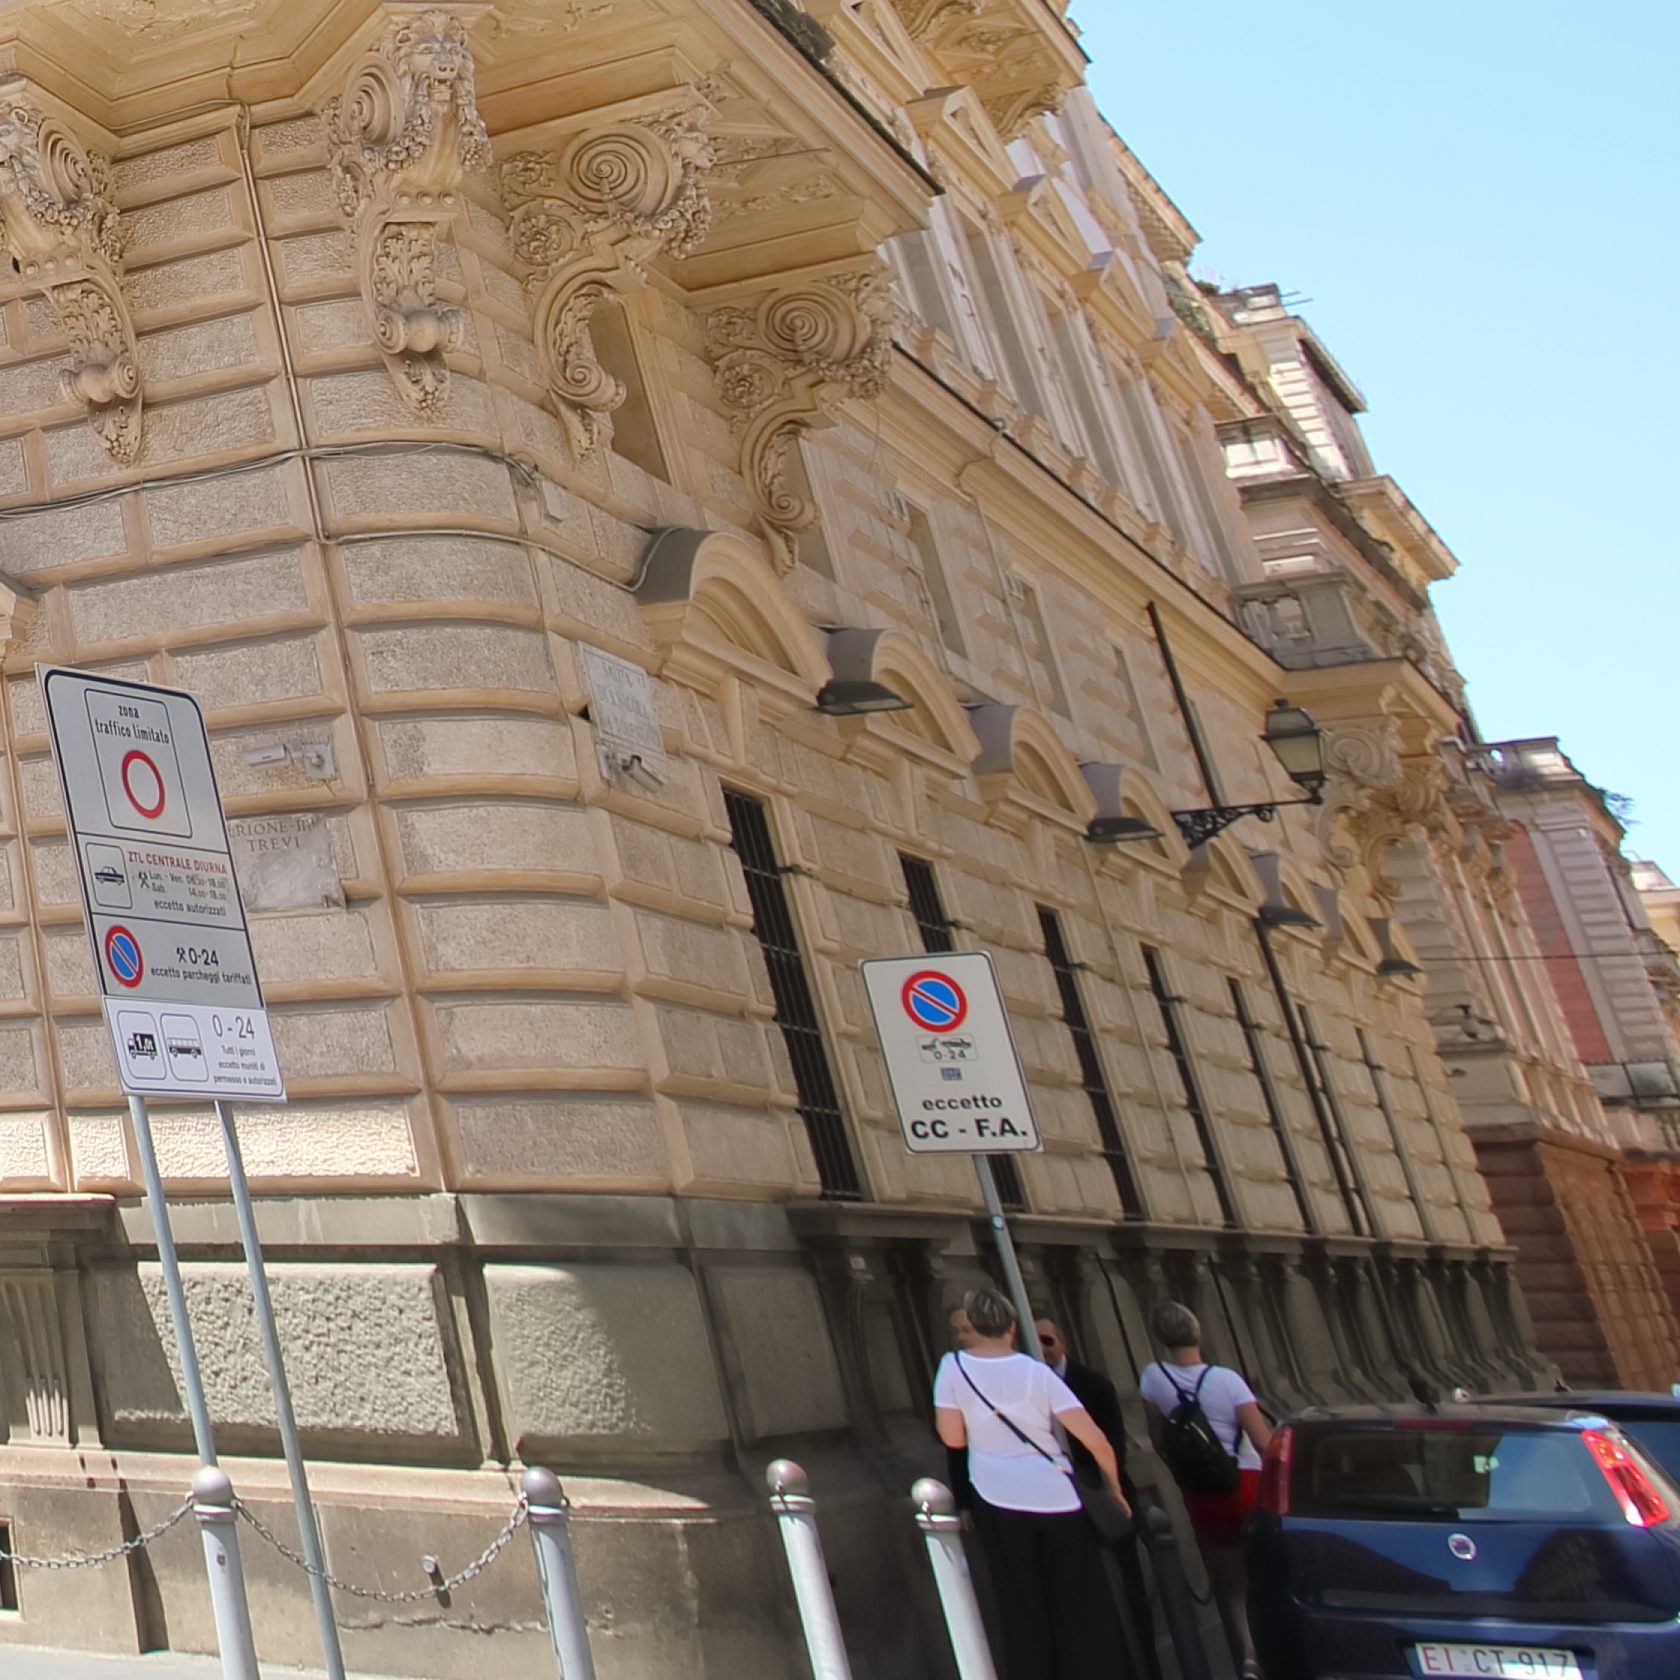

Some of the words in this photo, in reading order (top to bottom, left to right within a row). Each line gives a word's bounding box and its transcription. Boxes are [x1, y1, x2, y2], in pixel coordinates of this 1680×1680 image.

[118, 705, 140, 719] zona
[95, 718, 131, 738] traffico
[132, 722, 170, 744] limitato
[235, 821, 289, 837] RIONE
[247, 835, 300, 852] TREVI
[128, 851, 144, 864] ZTL
[146, 853, 191, 870] CENTRALE
[194, 860, 227, 874] DIURNA
[154, 900, 184, 912] eccetto
[186, 903, 227, 917] autorizzati
[188, 947, 219, 966] 0-24
[150, 966, 180, 979] eccetto
[183, 969, 219, 984] parcheggi
[222, 971, 252, 985] tariffati
[235, 1016, 255, 1039] 24
[922, 1094, 1003, 1111] eccetto
[911, 1120, 949, 1140] CC
[974, 1117, 1028, 1138] F.A.
[1422, 1646, 1455, 1672] EI
[1472, 1648, 1506, 1675] CT
[1516, 1650, 1569, 1678] 917
